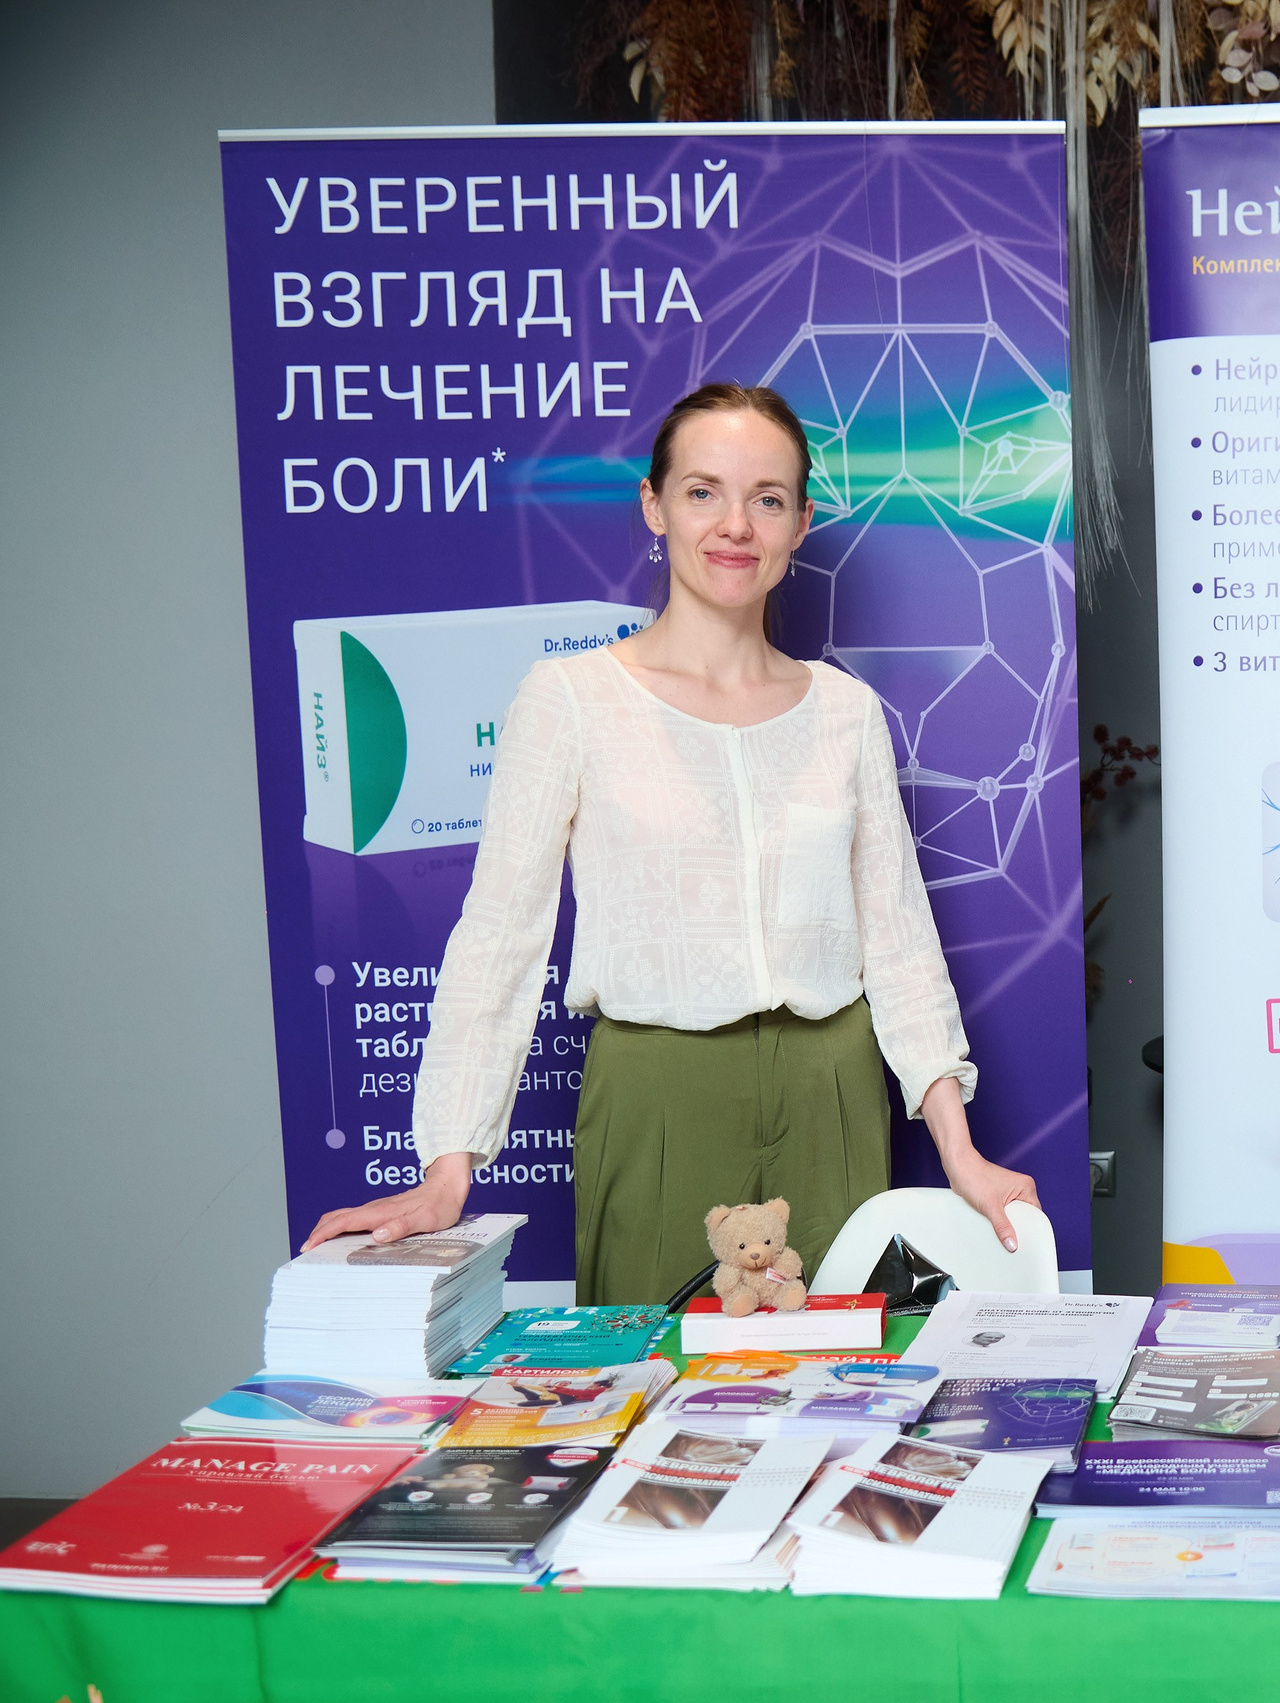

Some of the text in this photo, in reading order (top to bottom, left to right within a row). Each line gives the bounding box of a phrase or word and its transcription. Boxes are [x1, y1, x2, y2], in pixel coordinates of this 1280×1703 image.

[265, 158, 741, 235] УВЕРЕННЫЙ
[272, 267, 702, 339] ВЗГЛЯД НА
[277, 360, 632, 421] ЛЕЧЕНИЕ
[1213, 576, 1256, 600] Без
[1213, 651, 1227, 673] 3
[427, 822, 442, 833] 20
[151, 1457, 380, 1474] MANAGE PAIN
